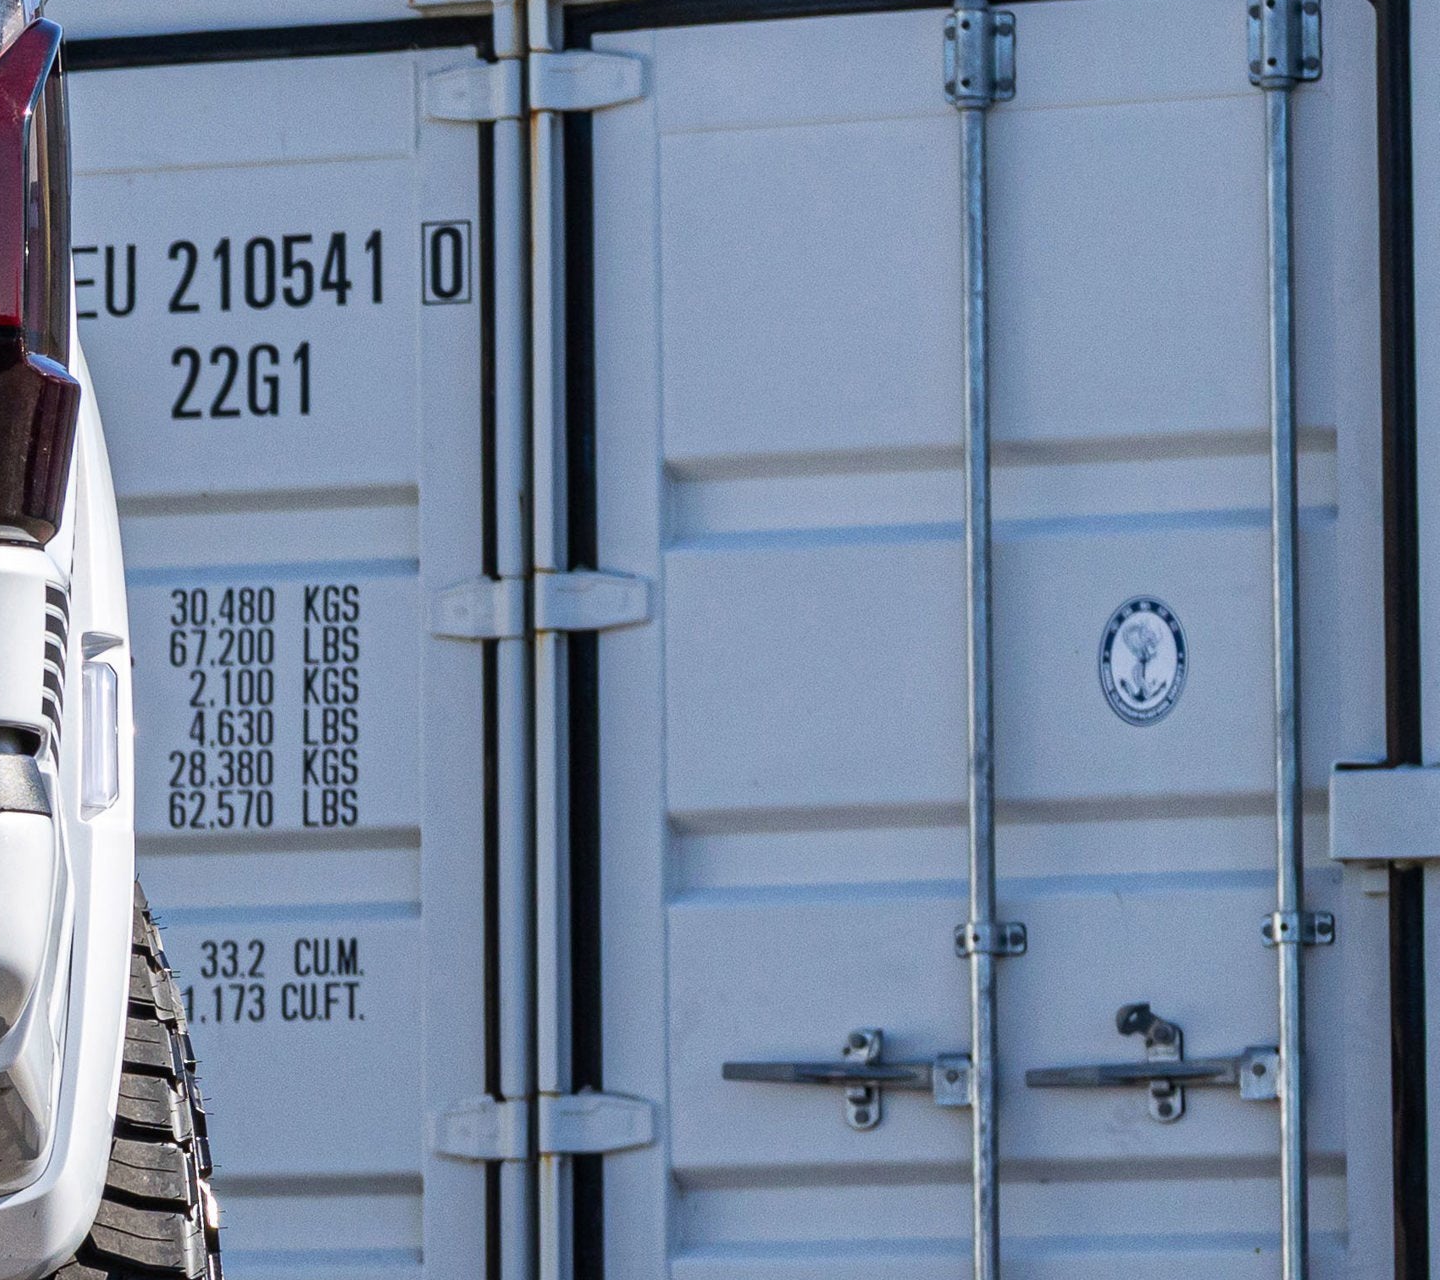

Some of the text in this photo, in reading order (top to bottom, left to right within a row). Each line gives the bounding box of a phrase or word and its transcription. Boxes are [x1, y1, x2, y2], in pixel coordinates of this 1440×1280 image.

[168, 228, 383, 313] 210541
[431, 226, 463, 299] 0
[171, 339, 310, 419] 22G1
[170, 585, 359, 626] 30.480 KGS
[169, 626, 359, 667] 67.200 LBS
[189, 667, 359, 707] 2.100 KGS
[189, 708, 359, 748] 4.630 LBS
[169, 748, 358, 789] 28.380 KGS
[168, 788, 358, 829] 62.570 LBS
[200, 939, 265, 979] 33.2
[182, 983, 265, 1023] 1.173
